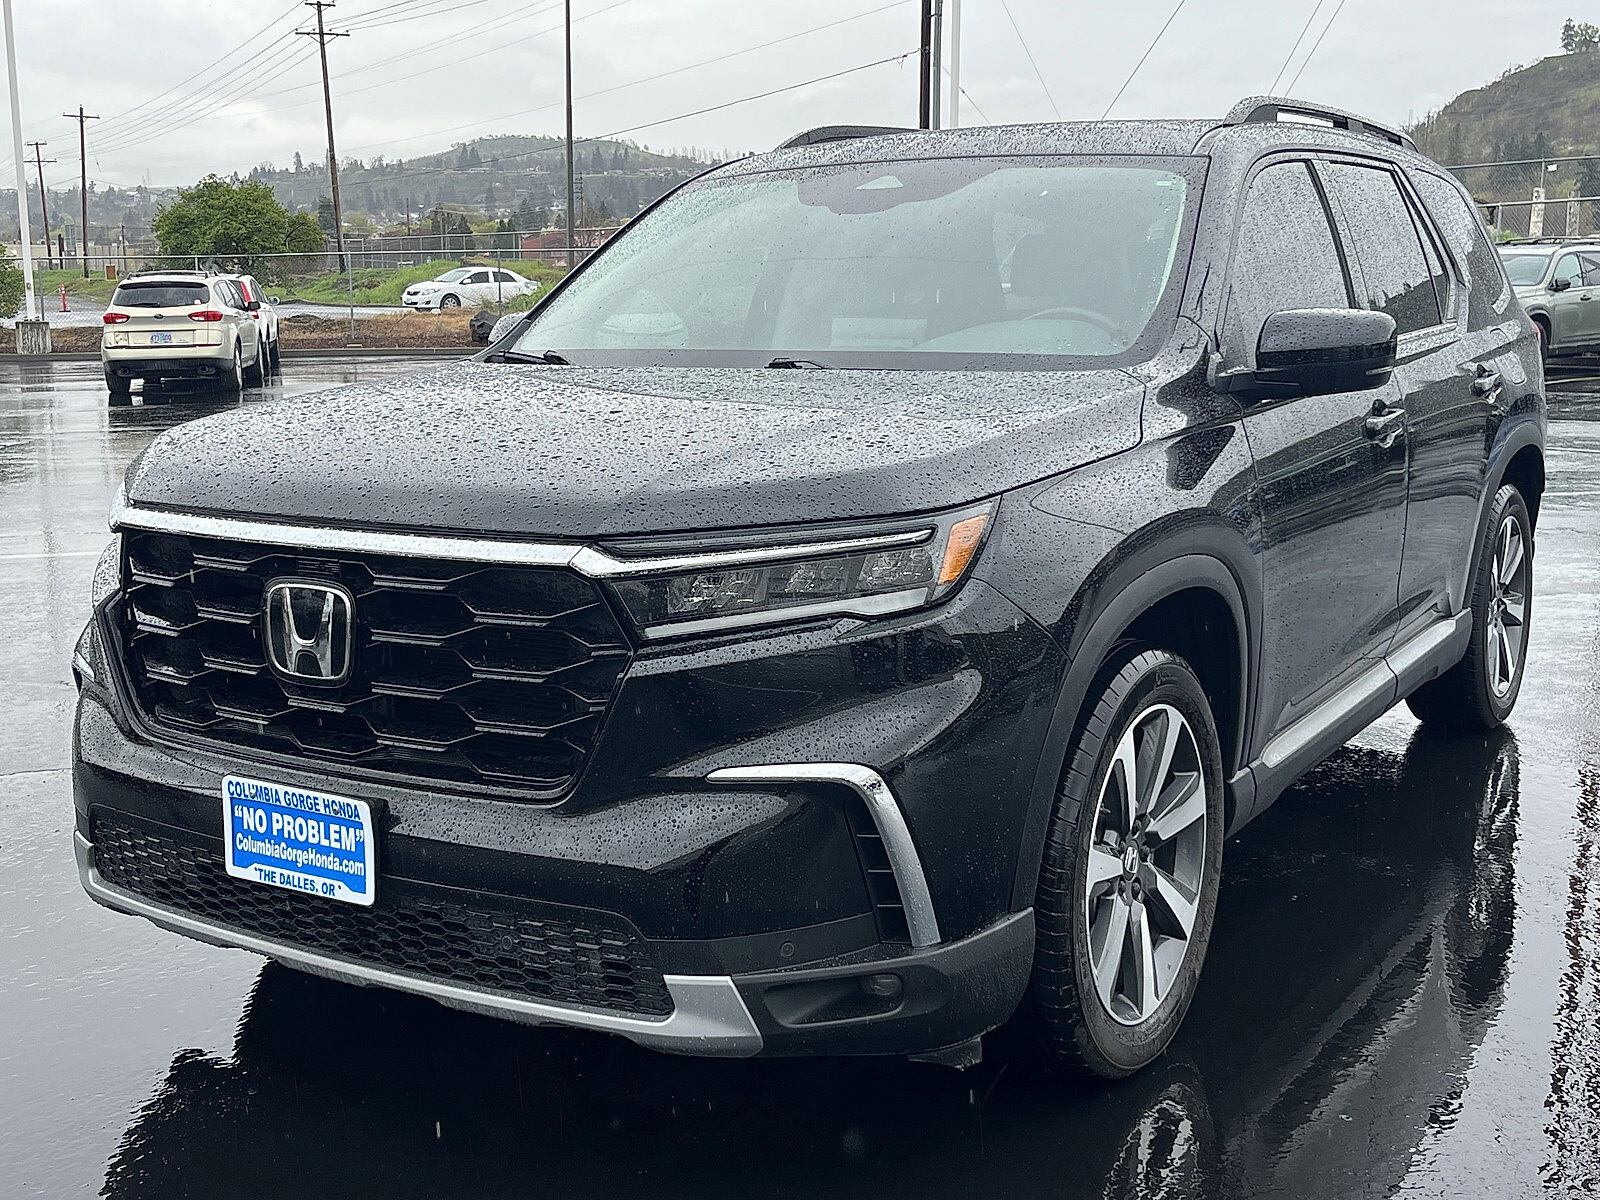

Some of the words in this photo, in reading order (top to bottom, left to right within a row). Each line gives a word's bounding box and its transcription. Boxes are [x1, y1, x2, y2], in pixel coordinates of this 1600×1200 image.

[227, 780, 281, 805] COLUMBIA
[283, 790, 321, 813] GORGE
[323, 799, 361, 820] HONDA
[235, 832, 364, 877] ColumbiaGorgeHonda.com
[279, 873, 319, 893] DALLES,
